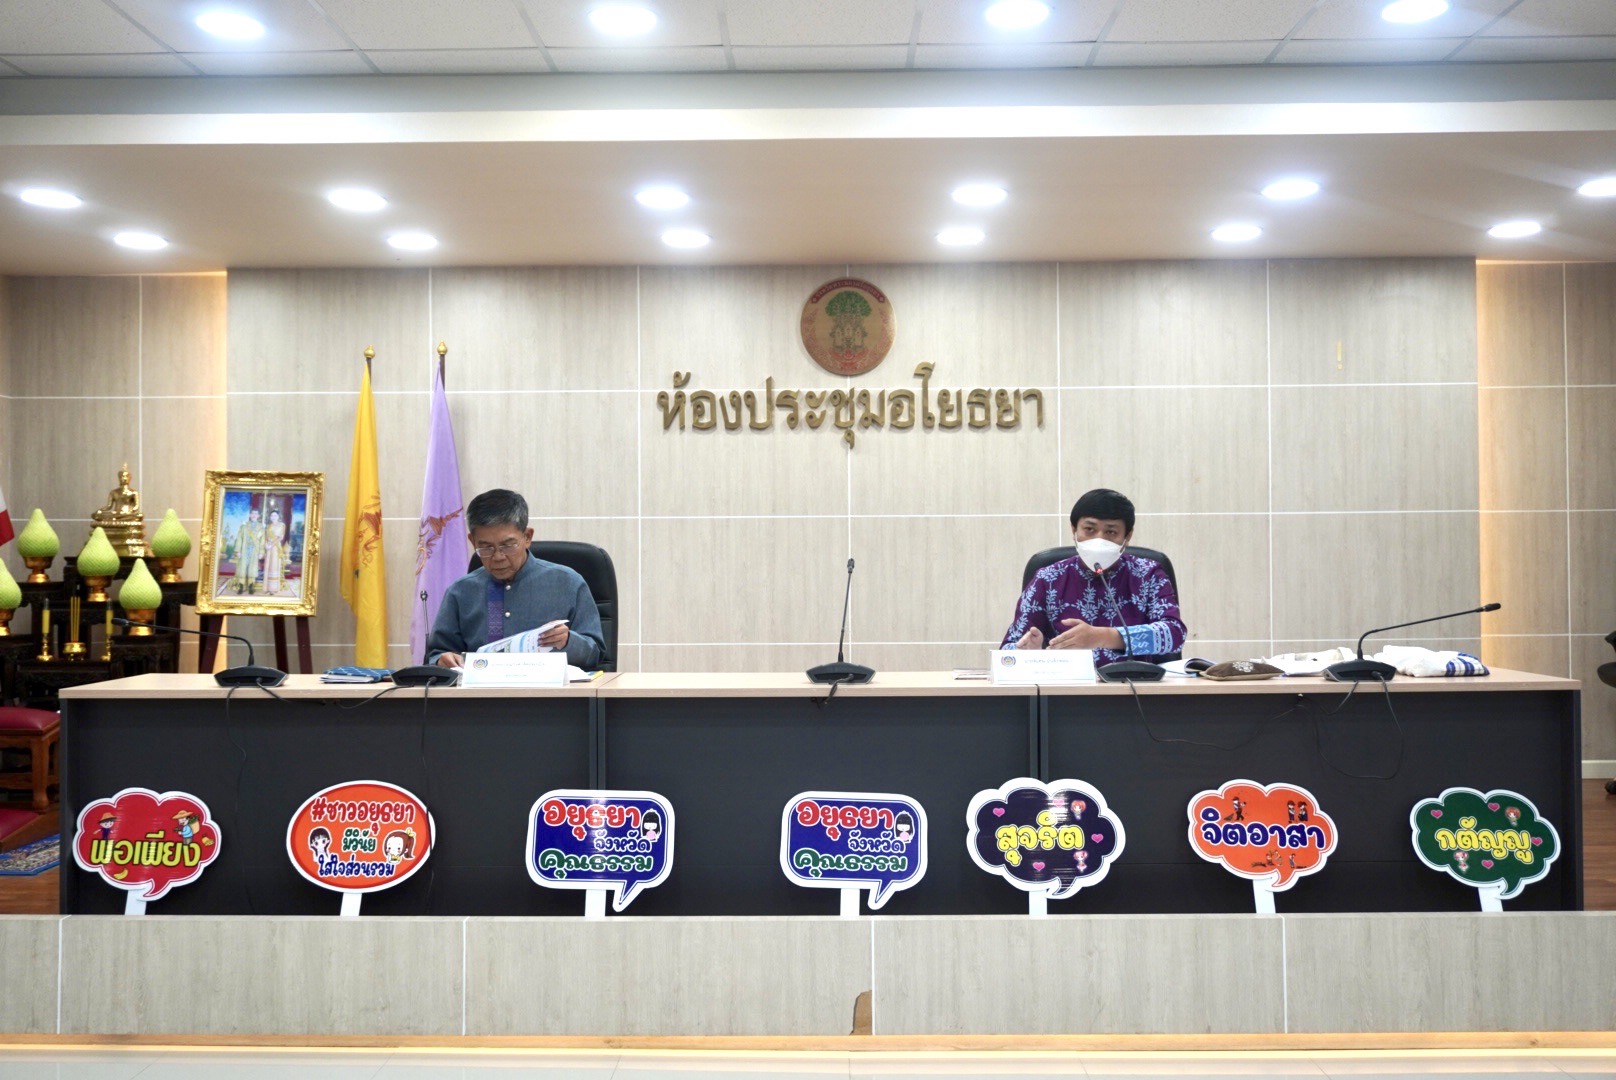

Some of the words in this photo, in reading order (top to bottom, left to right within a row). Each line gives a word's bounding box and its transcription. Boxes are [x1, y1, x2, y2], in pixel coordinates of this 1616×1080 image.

[656, 361, 1043, 449] ห้องประชุมอโยธยา
[311, 798, 415, 834] #ชาวอยุธยา
[543, 799, 641, 840] อยุธยา
[797, 800, 894, 840] อยุธยา
[1202, 808, 1325, 848] จิตอาสา
[91, 830, 201, 866] พอเพียง
[342, 828, 376, 851] มีวินัย
[594, 829, 651, 852] จังหวัด
[849, 830, 905, 852] จังหวัด
[996, 811, 1085, 866] สุจริต
[1436, 817, 1533, 863] กตัญญู
[540, 850, 653, 879] คุณธรรม
[795, 849, 907, 878] คุณธรรม
